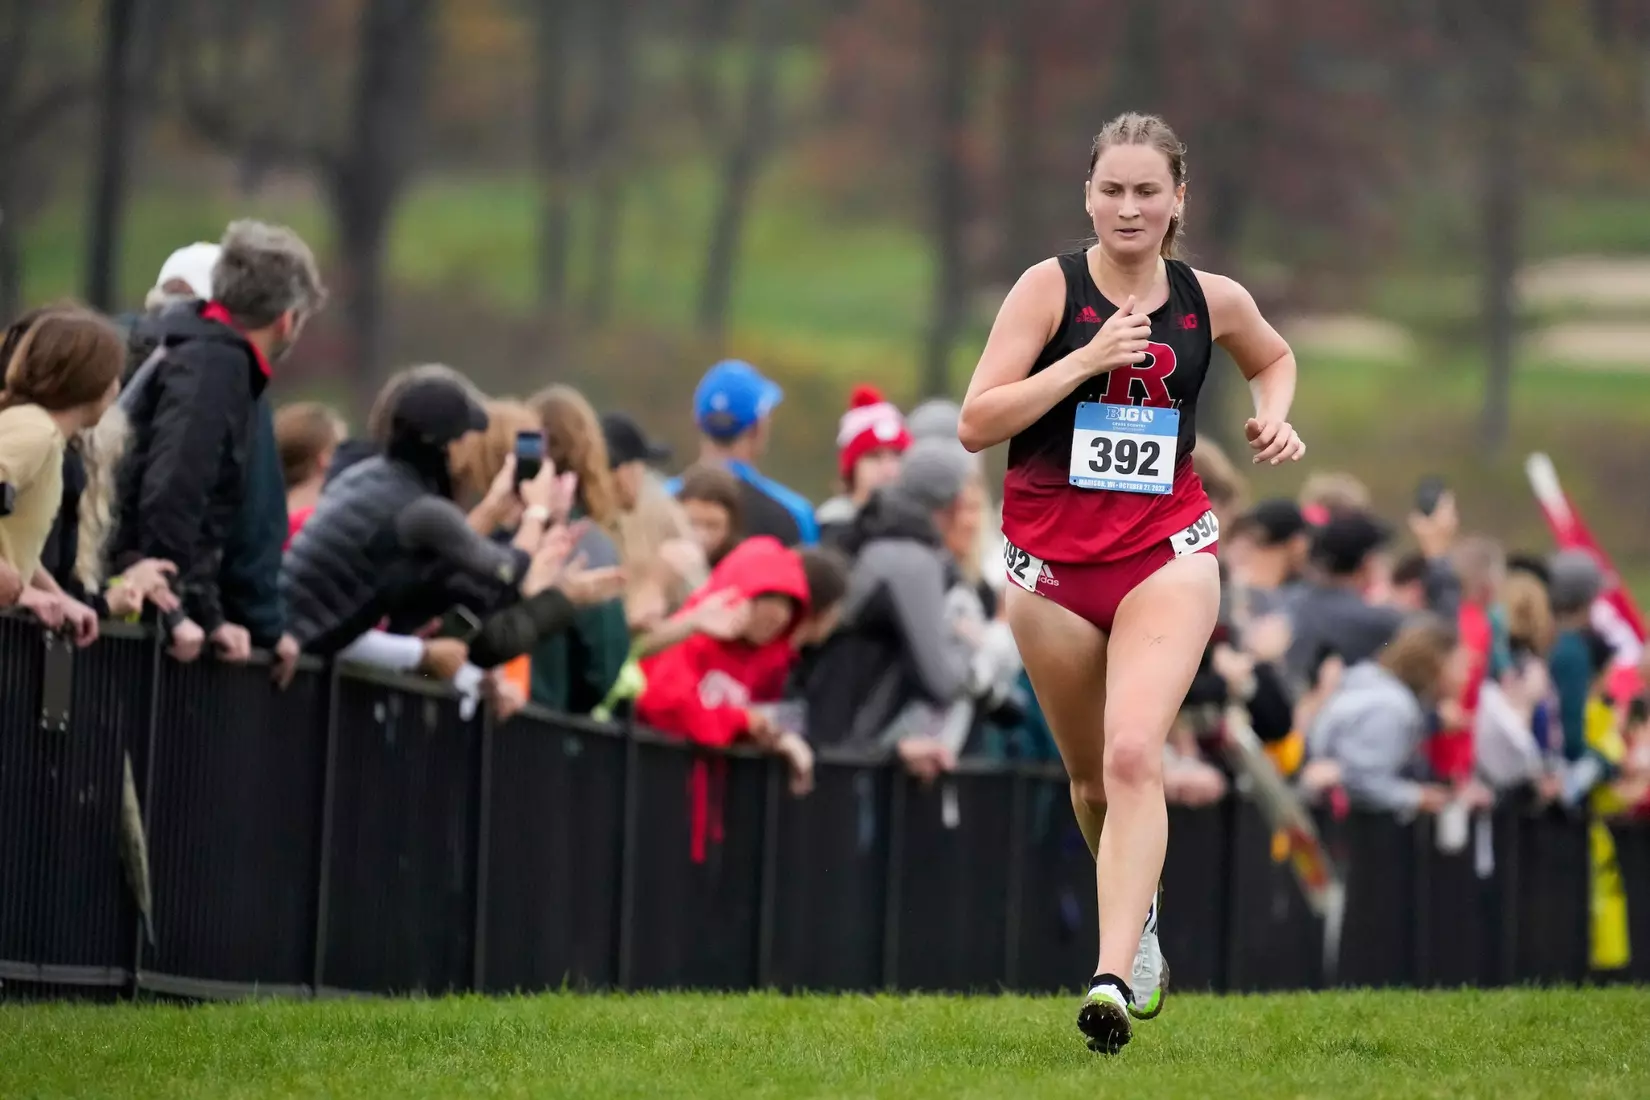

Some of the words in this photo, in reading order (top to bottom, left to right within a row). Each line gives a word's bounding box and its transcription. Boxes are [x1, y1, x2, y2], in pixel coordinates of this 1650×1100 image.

[1099, 341, 1177, 408] R
[1088, 437, 1160, 476] 392
[1118, 482, 1143, 490] OCTOBER
